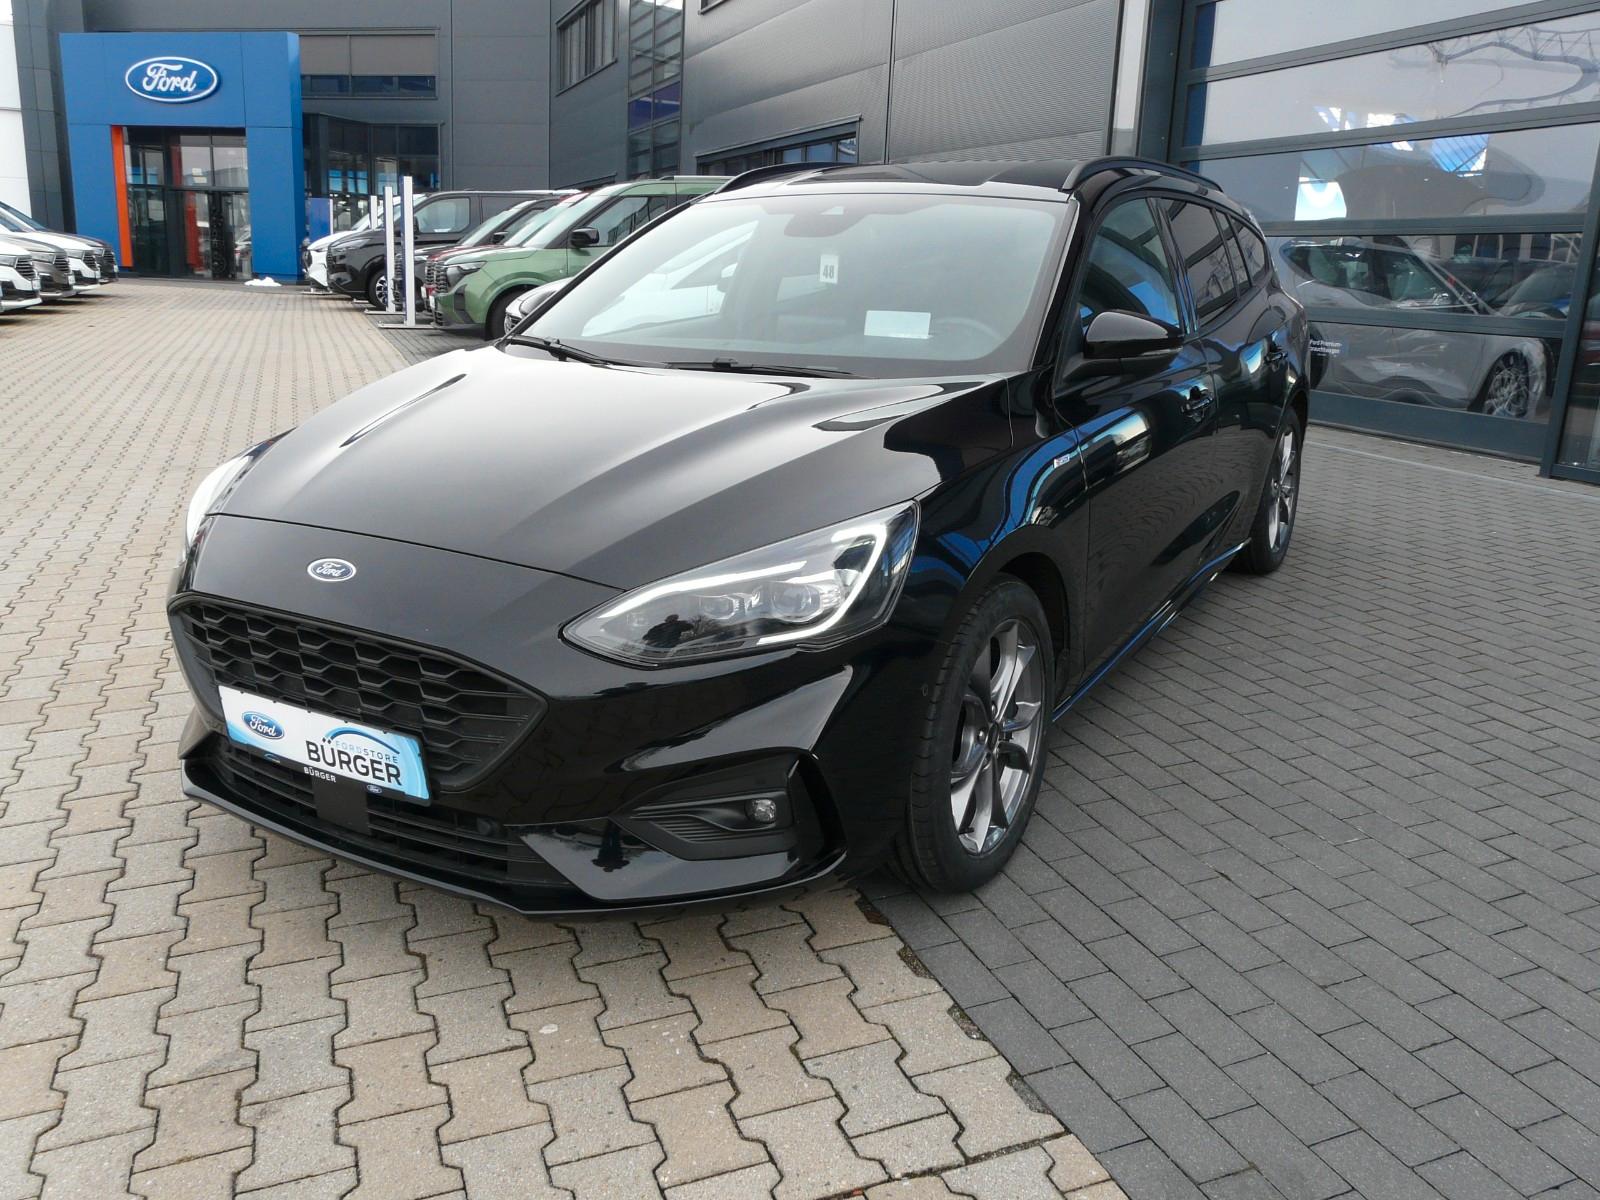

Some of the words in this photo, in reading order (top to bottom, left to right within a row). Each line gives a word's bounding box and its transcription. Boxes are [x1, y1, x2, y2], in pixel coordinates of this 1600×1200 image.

[142, 63, 197, 92] Ford
[822, 265, 835, 279] 48
[316, 562, 345, 576] Ford
[250, 715, 276, 736] Ford
[306, 737, 402, 786] BÜRGER
[336, 740, 399, 764] FORDSTORE
[303, 766, 337, 782] BÜRGER
